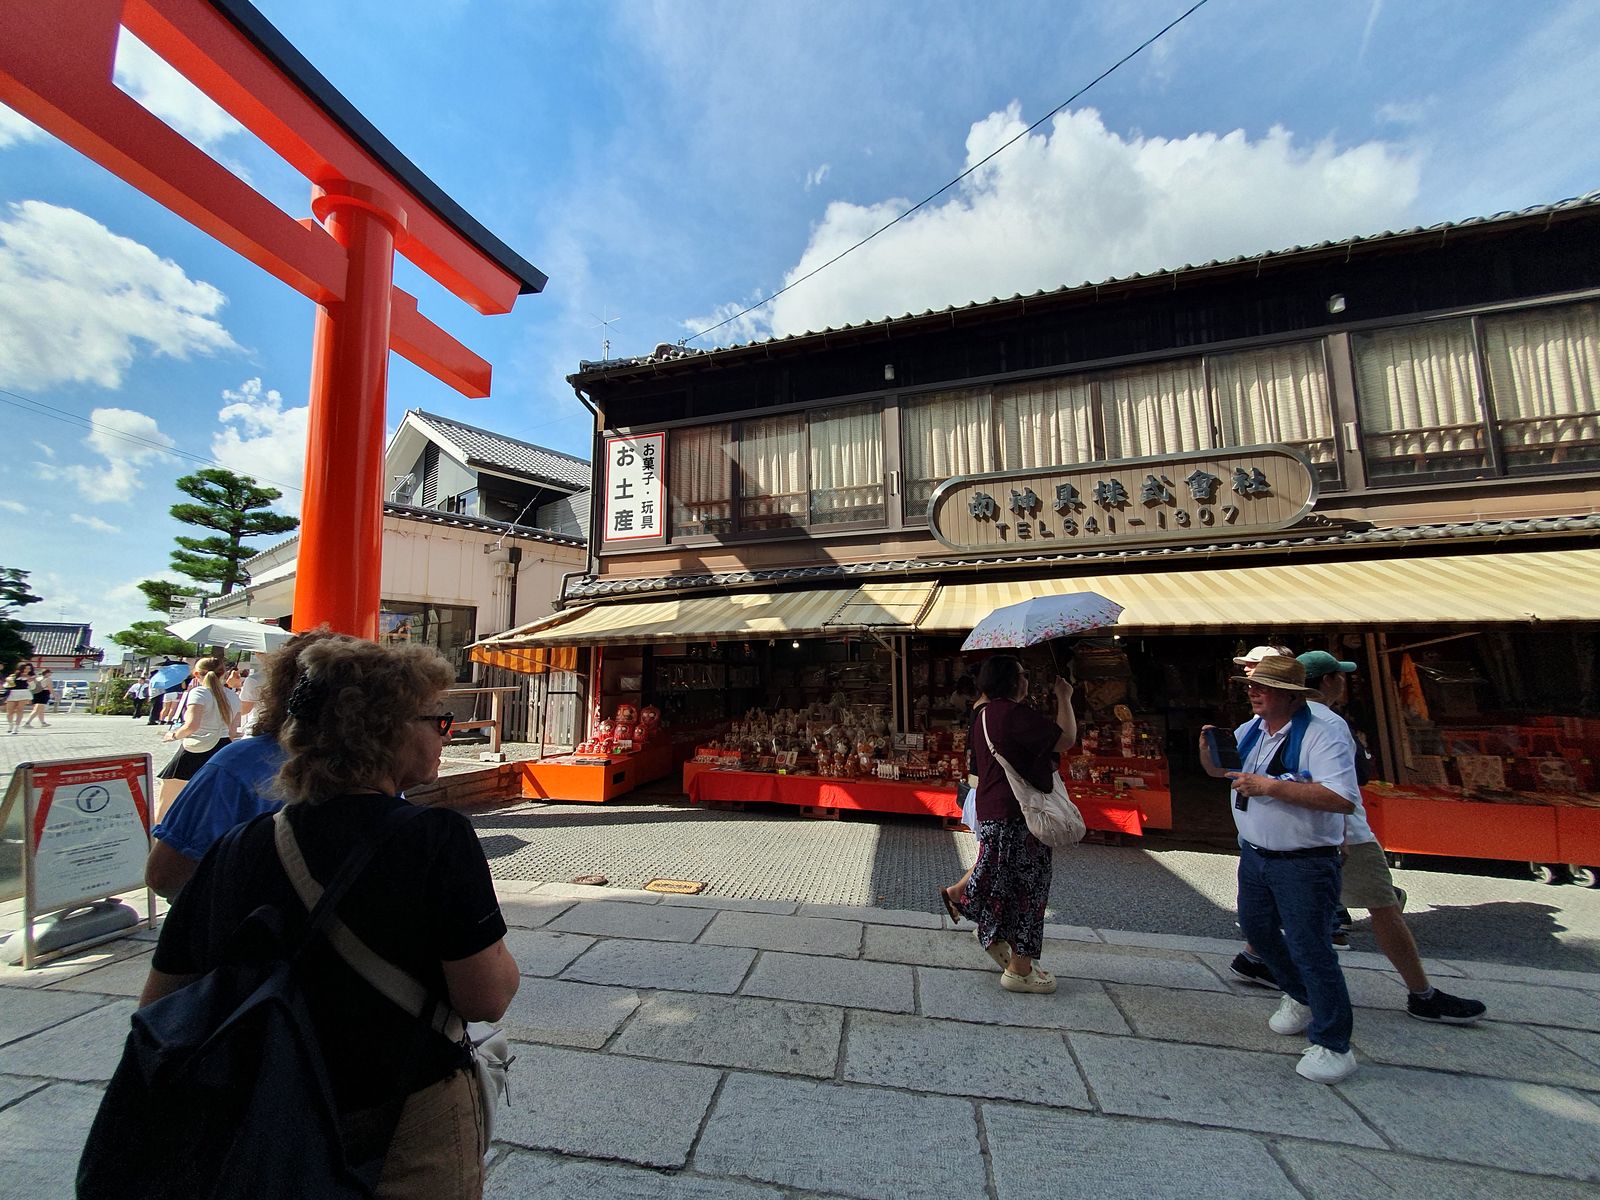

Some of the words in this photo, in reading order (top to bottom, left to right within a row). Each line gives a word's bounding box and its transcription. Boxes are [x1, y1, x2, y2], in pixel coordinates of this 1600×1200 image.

[613, 446, 635, 532] お土産
[640, 443, 655, 529] お菓子・玩具
[995, 519, 1055, 539] TEL
[1063, 504, 1238, 535] 641-1307
